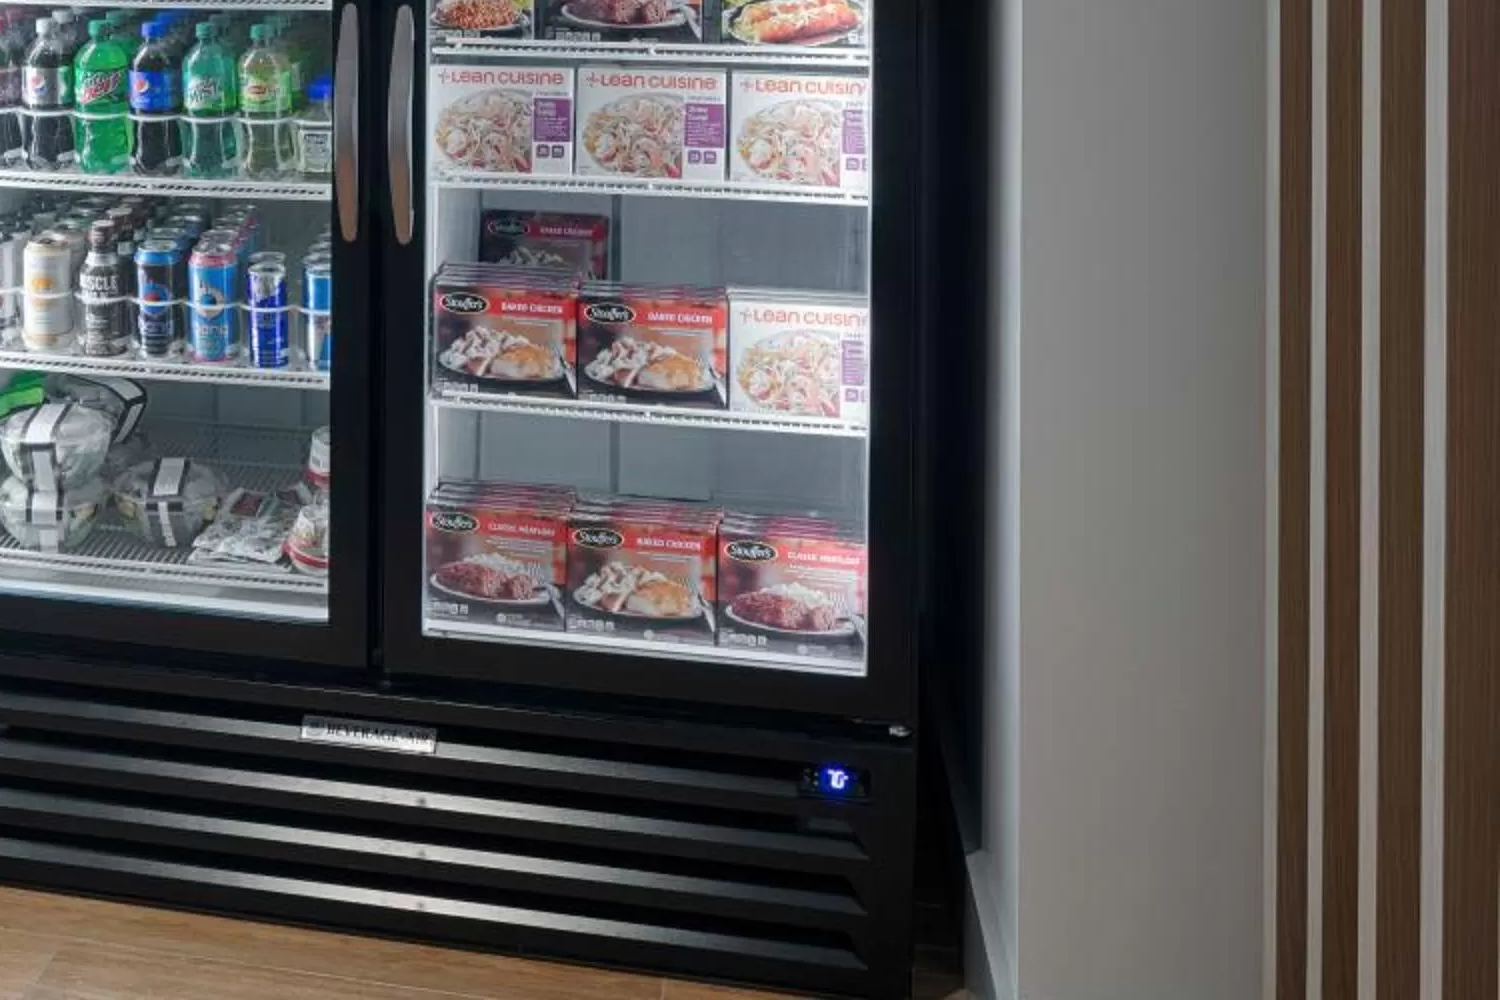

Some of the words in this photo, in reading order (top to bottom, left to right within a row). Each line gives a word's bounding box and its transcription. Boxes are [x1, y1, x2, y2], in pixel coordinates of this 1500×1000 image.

[805, 80, 866, 95] cuisin
[444, 294, 484, 312] Stouffer's
[589, 304, 632, 322] Stouffer's
[804, 311, 867, 327] cuisin
